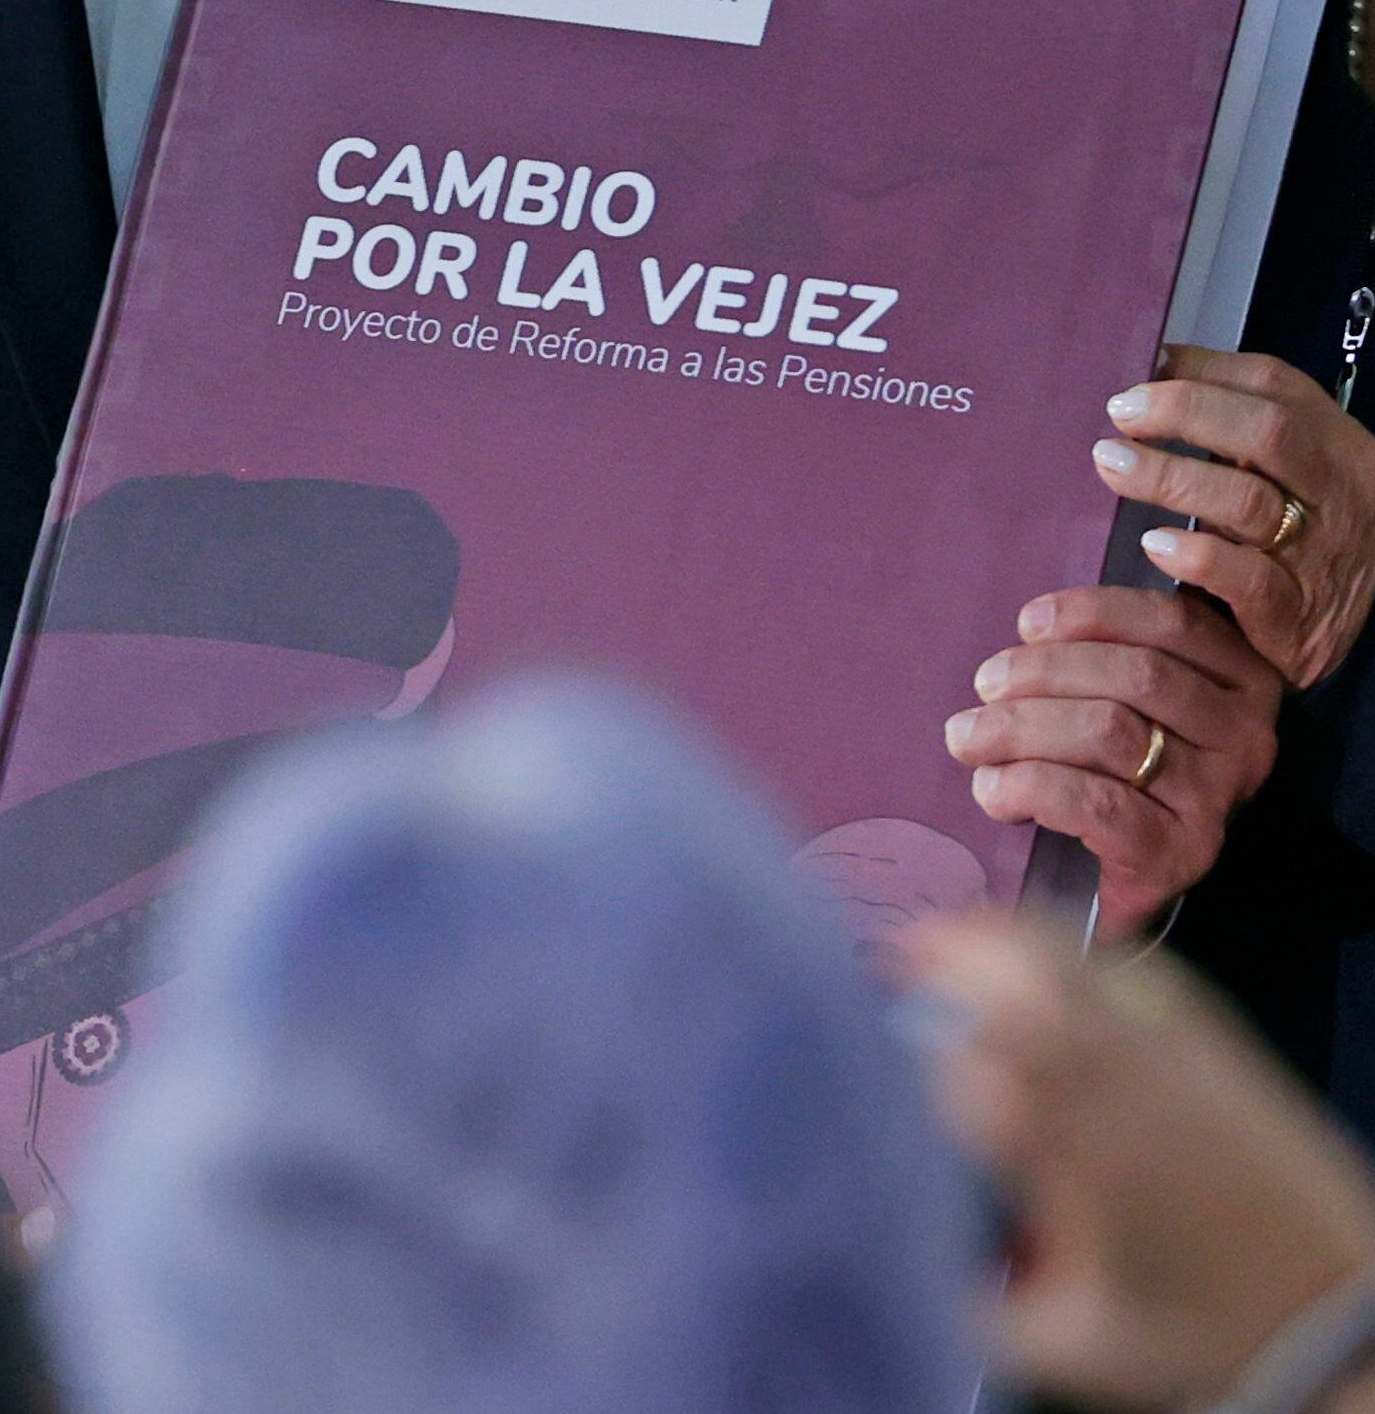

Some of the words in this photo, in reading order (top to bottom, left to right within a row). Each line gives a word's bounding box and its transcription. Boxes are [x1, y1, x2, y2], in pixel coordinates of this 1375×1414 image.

[317, 137, 655, 237] CAMBIO
[293, 215, 477, 300] POR
[497, 240, 605, 317] LA
[640, 257, 899, 353] VEJEZ
[277, 291, 441, 344] Proyecto
[452, 315, 499, 351] de
[509, 320, 669, 373] Reforma
[680, 352, 702, 377] a
[713, 346, 767, 385] las
[777, 354, 974, 413] Pensiones
